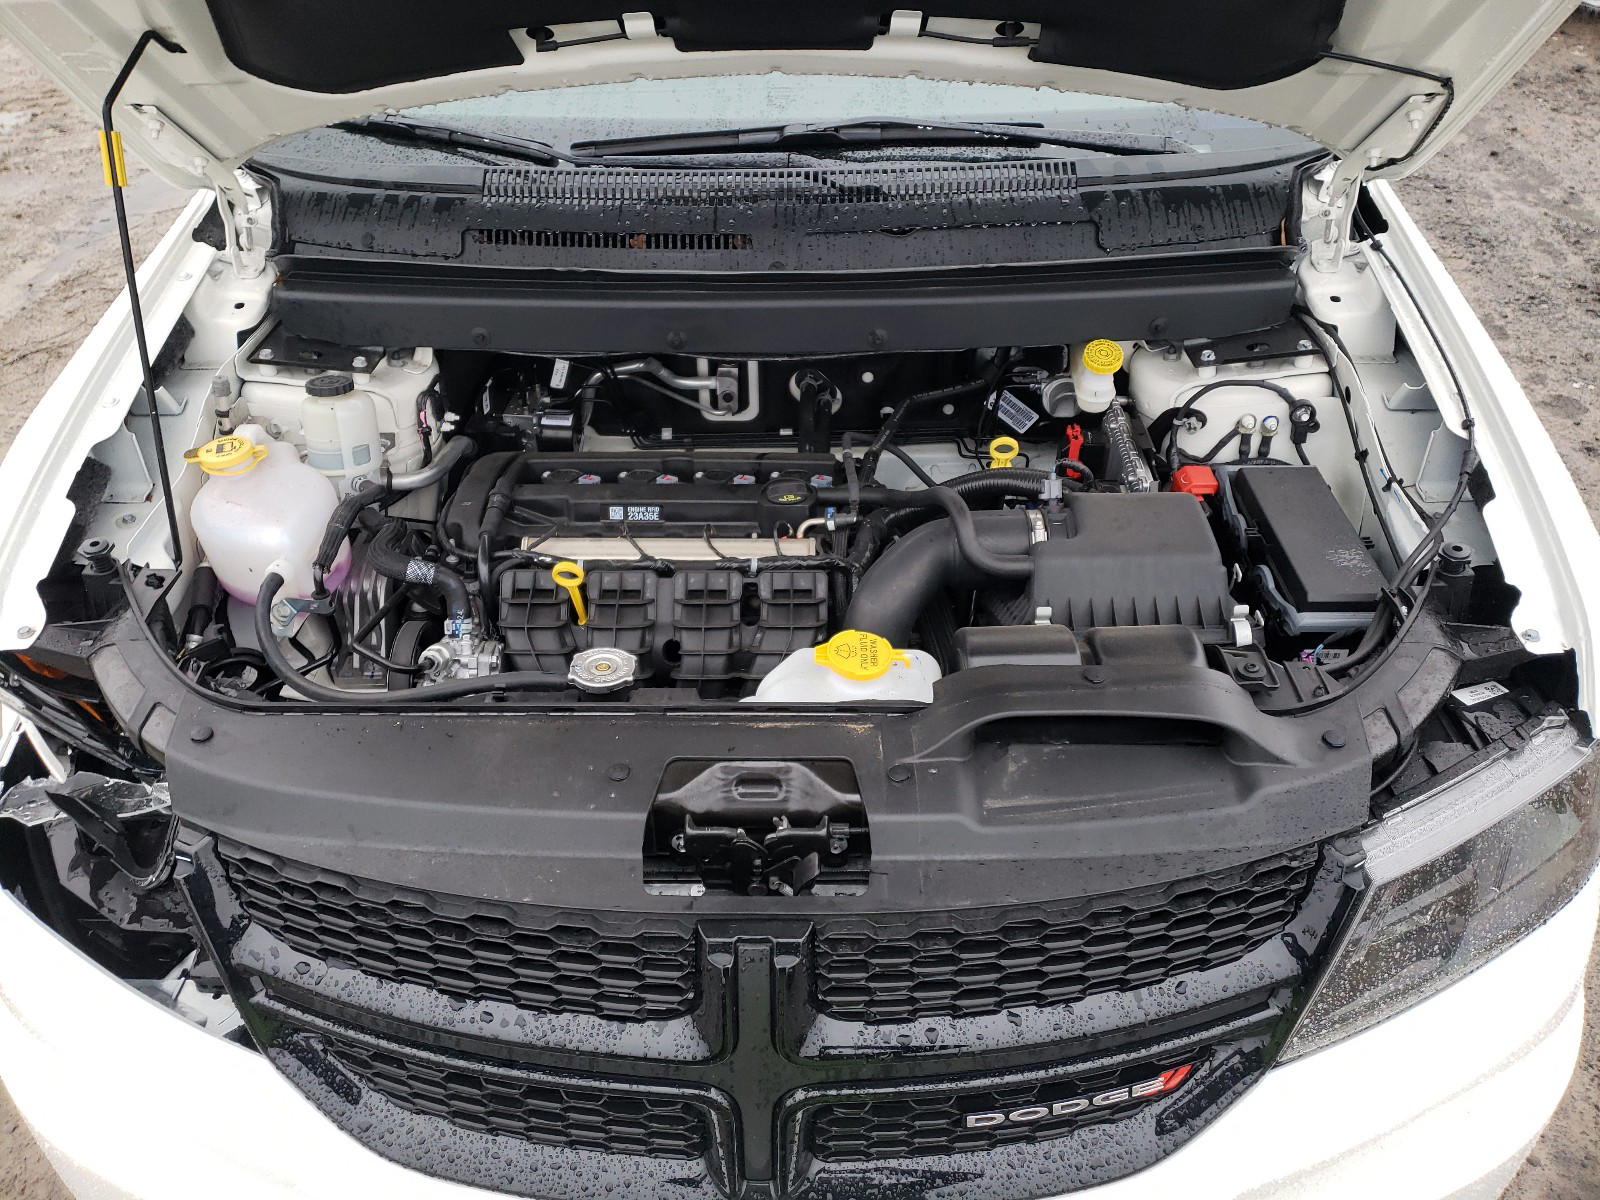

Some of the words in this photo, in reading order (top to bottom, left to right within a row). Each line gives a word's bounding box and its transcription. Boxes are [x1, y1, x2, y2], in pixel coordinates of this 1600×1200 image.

[627, 512, 660, 521] 23A35E
[859, 633, 868, 653] FLUID
[869, 638, 878, 668] WASHER
[860, 653, 869, 671] ONLY
[966, 1076, 1166, 1128] DODGE
